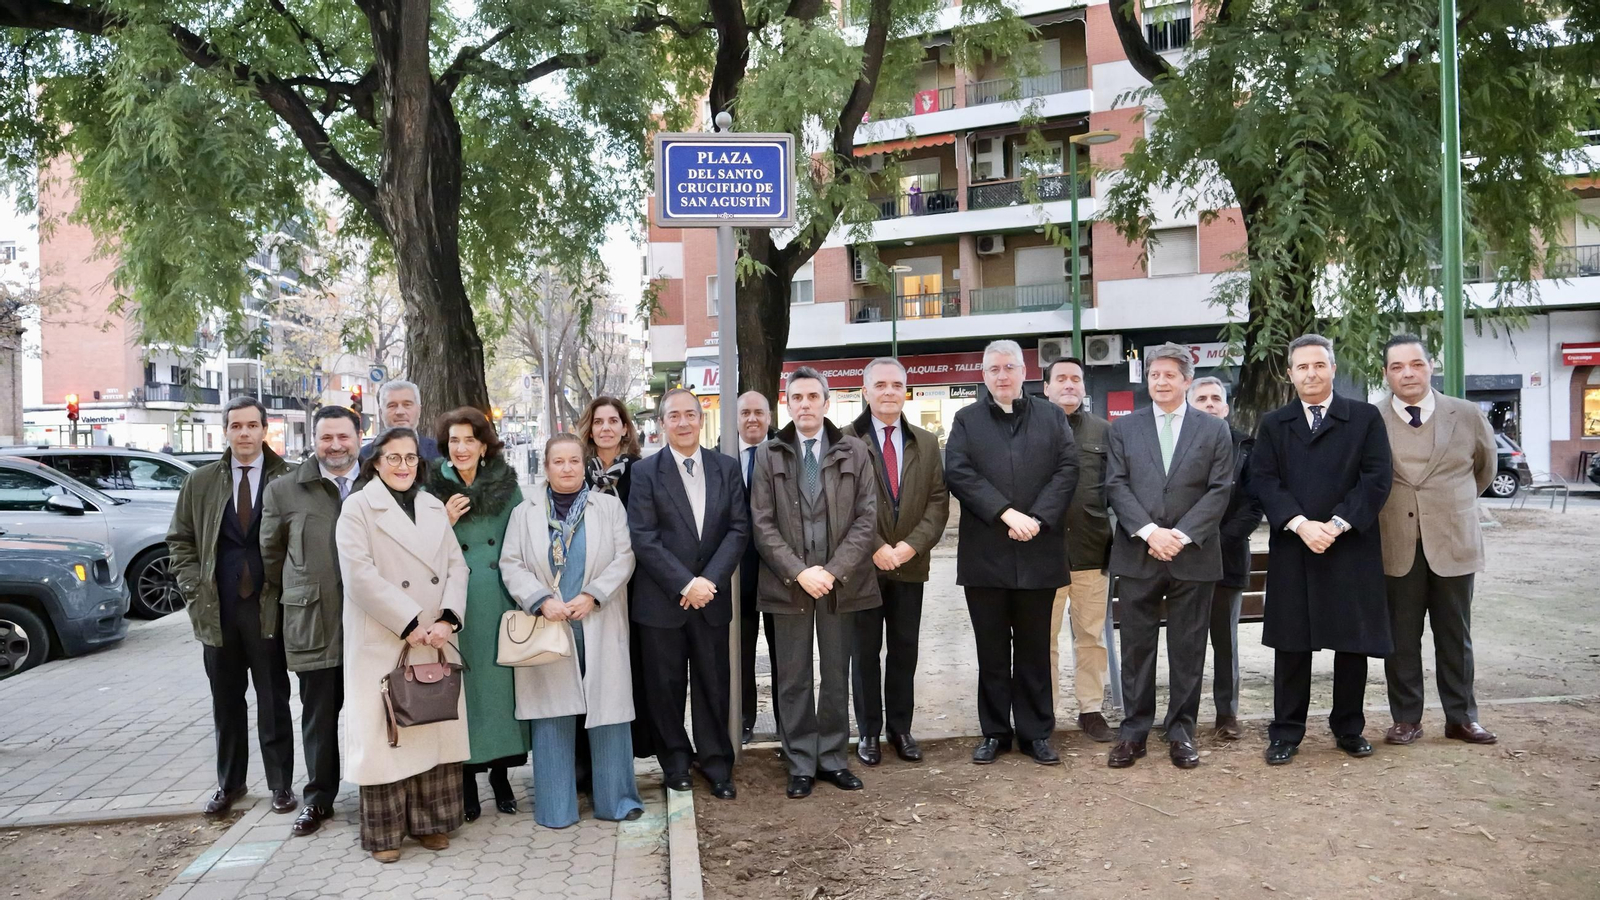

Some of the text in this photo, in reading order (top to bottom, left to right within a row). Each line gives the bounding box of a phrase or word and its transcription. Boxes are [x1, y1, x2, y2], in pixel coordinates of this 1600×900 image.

[697, 152, 753, 164] PLAZA
[688, 169, 764, 180] DEL SANTO
[677, 183, 774, 194] CRUCIFIJO DE
[680, 194, 771, 208] SAN AGUSTÍN
[822, 368, 863, 378] RECAMBIO
[906, 364, 949, 374] ALQUILER
[837, 391, 861, 399] CHAMPION
[81, 416, 114, 424] Valentine
